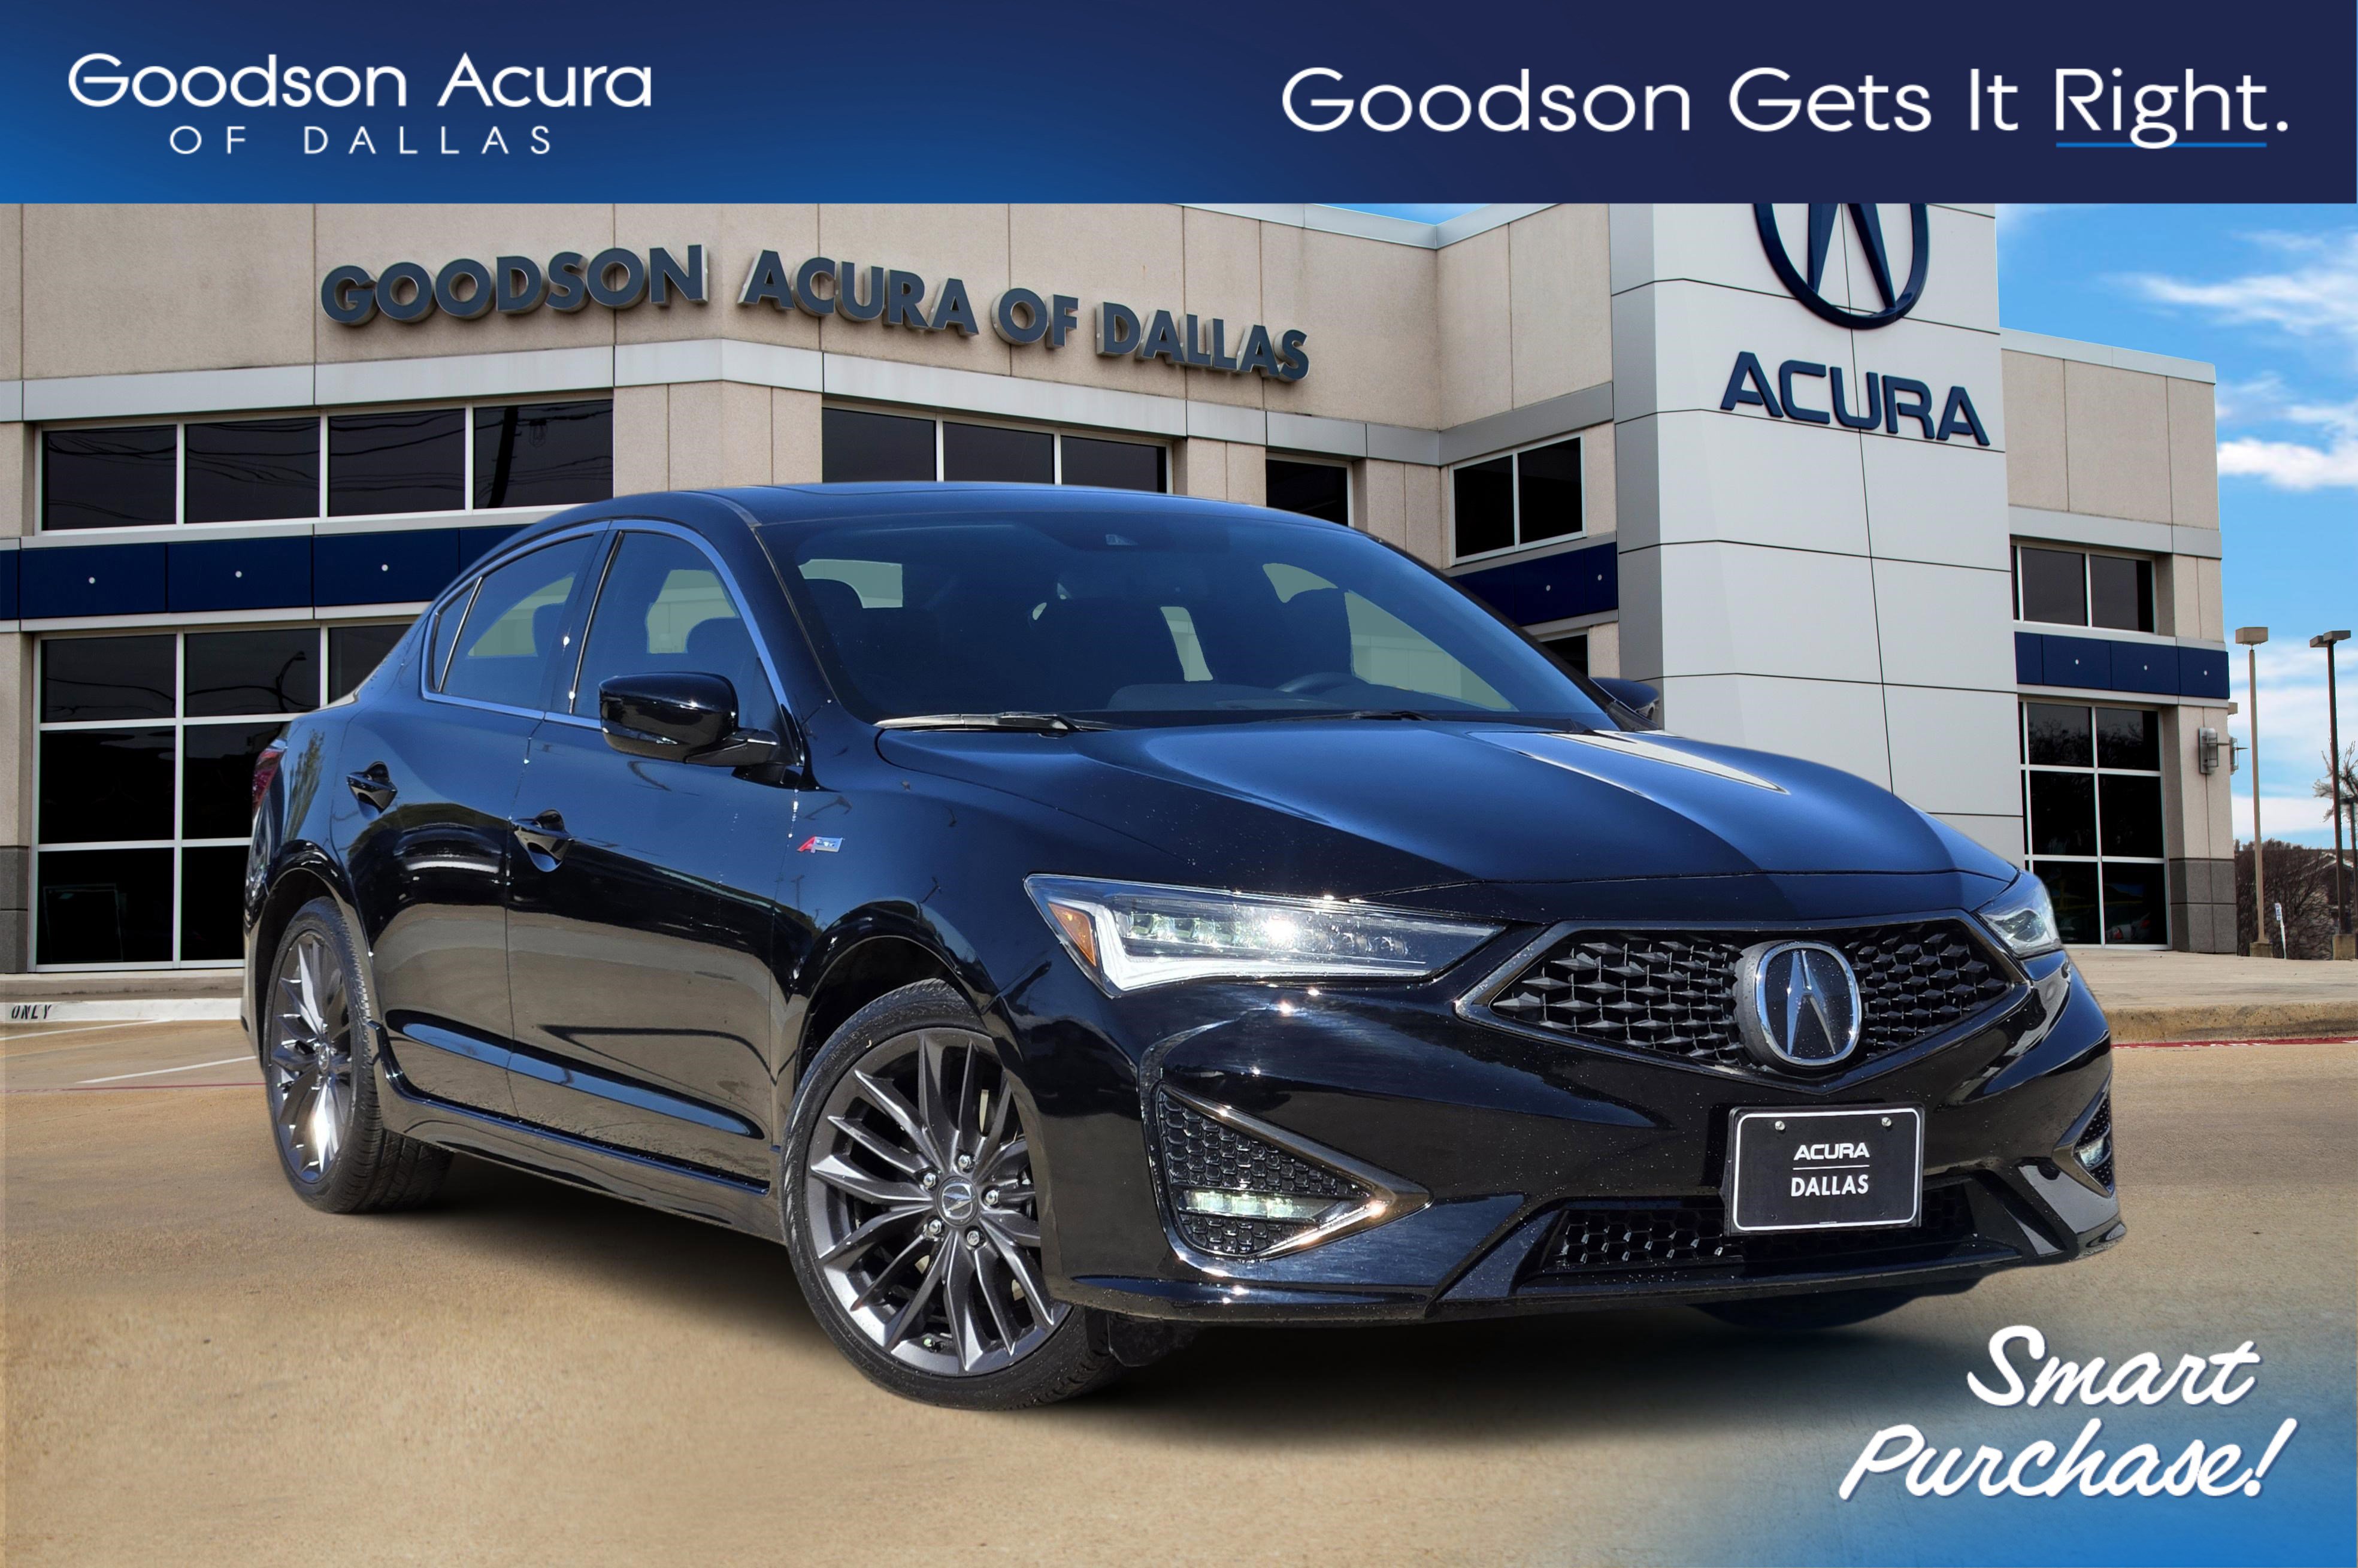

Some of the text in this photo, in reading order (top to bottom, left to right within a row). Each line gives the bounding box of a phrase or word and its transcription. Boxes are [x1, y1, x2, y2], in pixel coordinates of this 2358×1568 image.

[320, 245, 1310, 382] GOODSON ACURA OF DALLAS
[1720, 351, 1991, 447] ACURA
[11, 1004, 52, 1019] ONLY
[1793, 1142, 1870, 1161] ACURA
[1791, 1174, 1869, 1197] DALLAS
